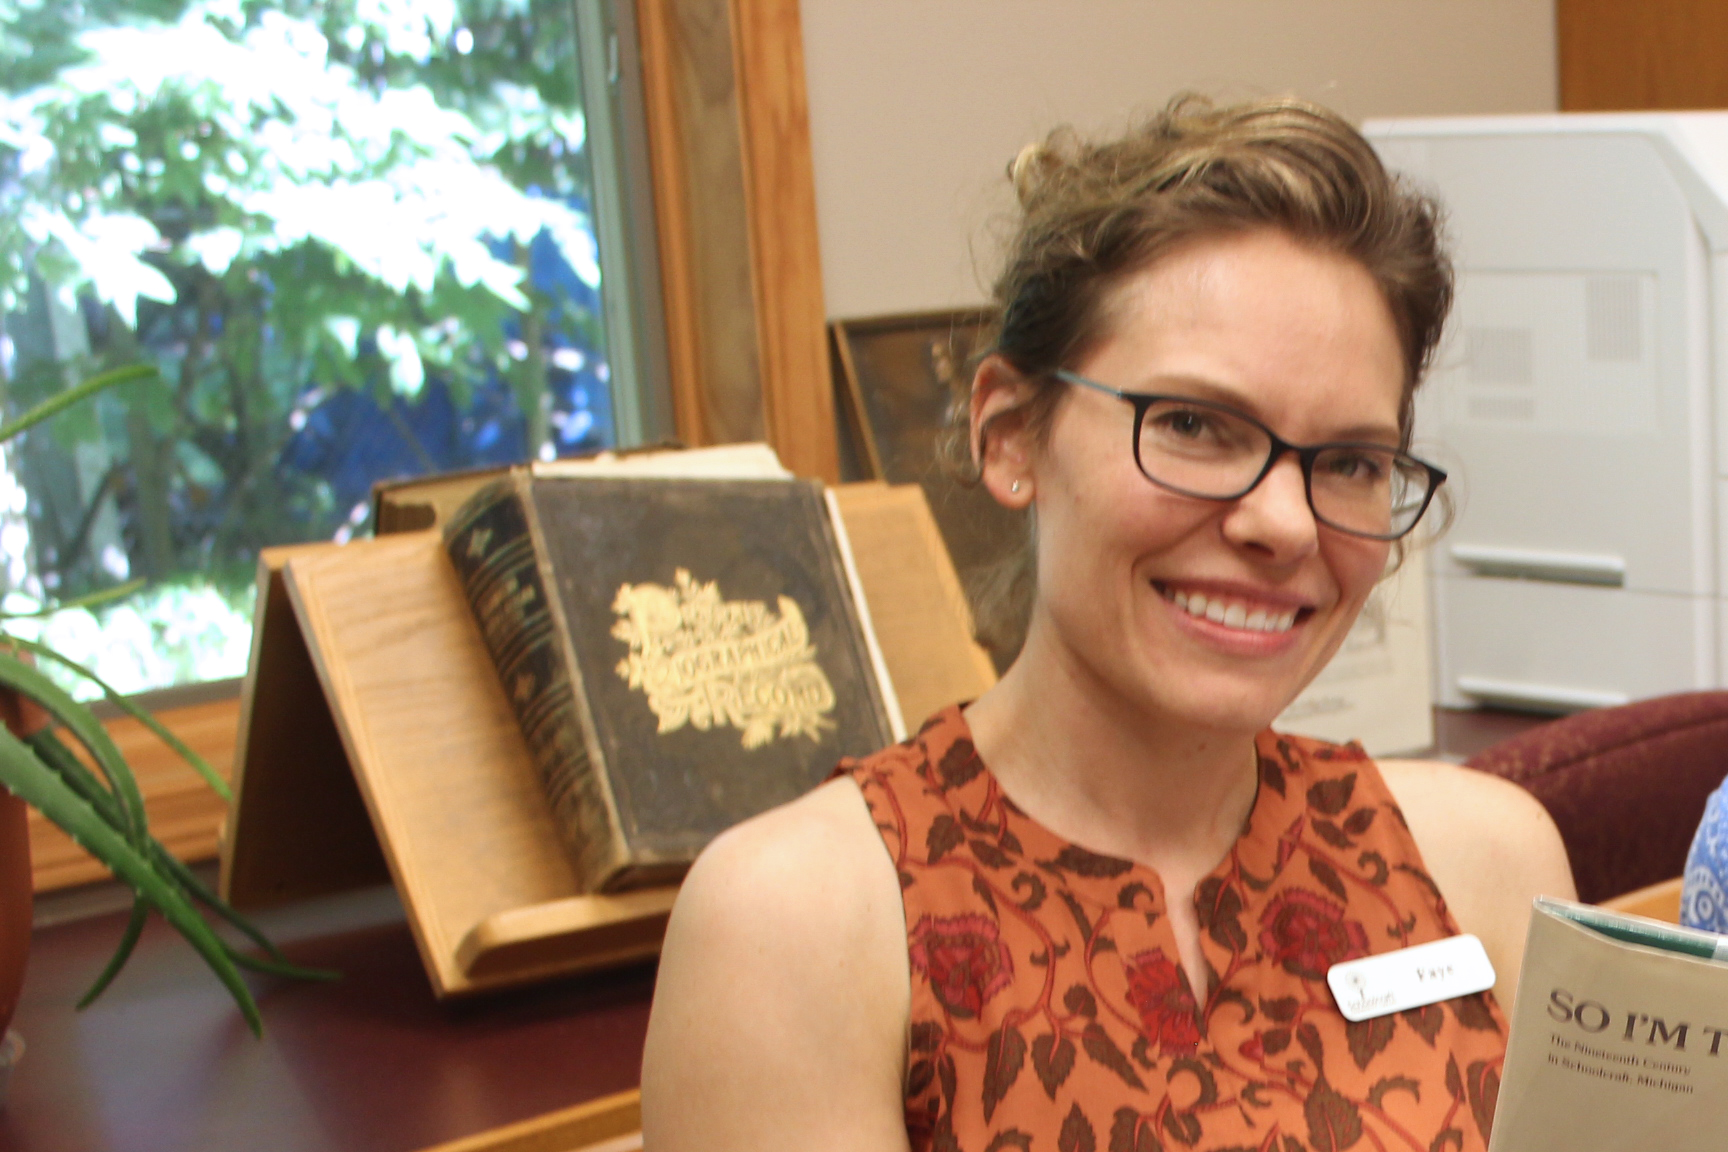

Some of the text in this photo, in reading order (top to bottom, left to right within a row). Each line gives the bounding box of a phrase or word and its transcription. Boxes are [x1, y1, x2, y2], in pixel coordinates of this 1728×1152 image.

[1547, 988, 1611, 1034] SO
[1622, 1011, 1691, 1051] I'M
[1550, 1033, 1691, 1077] The Nineteenth Century
[1637, 1073, 1694, 1095] Michigan
